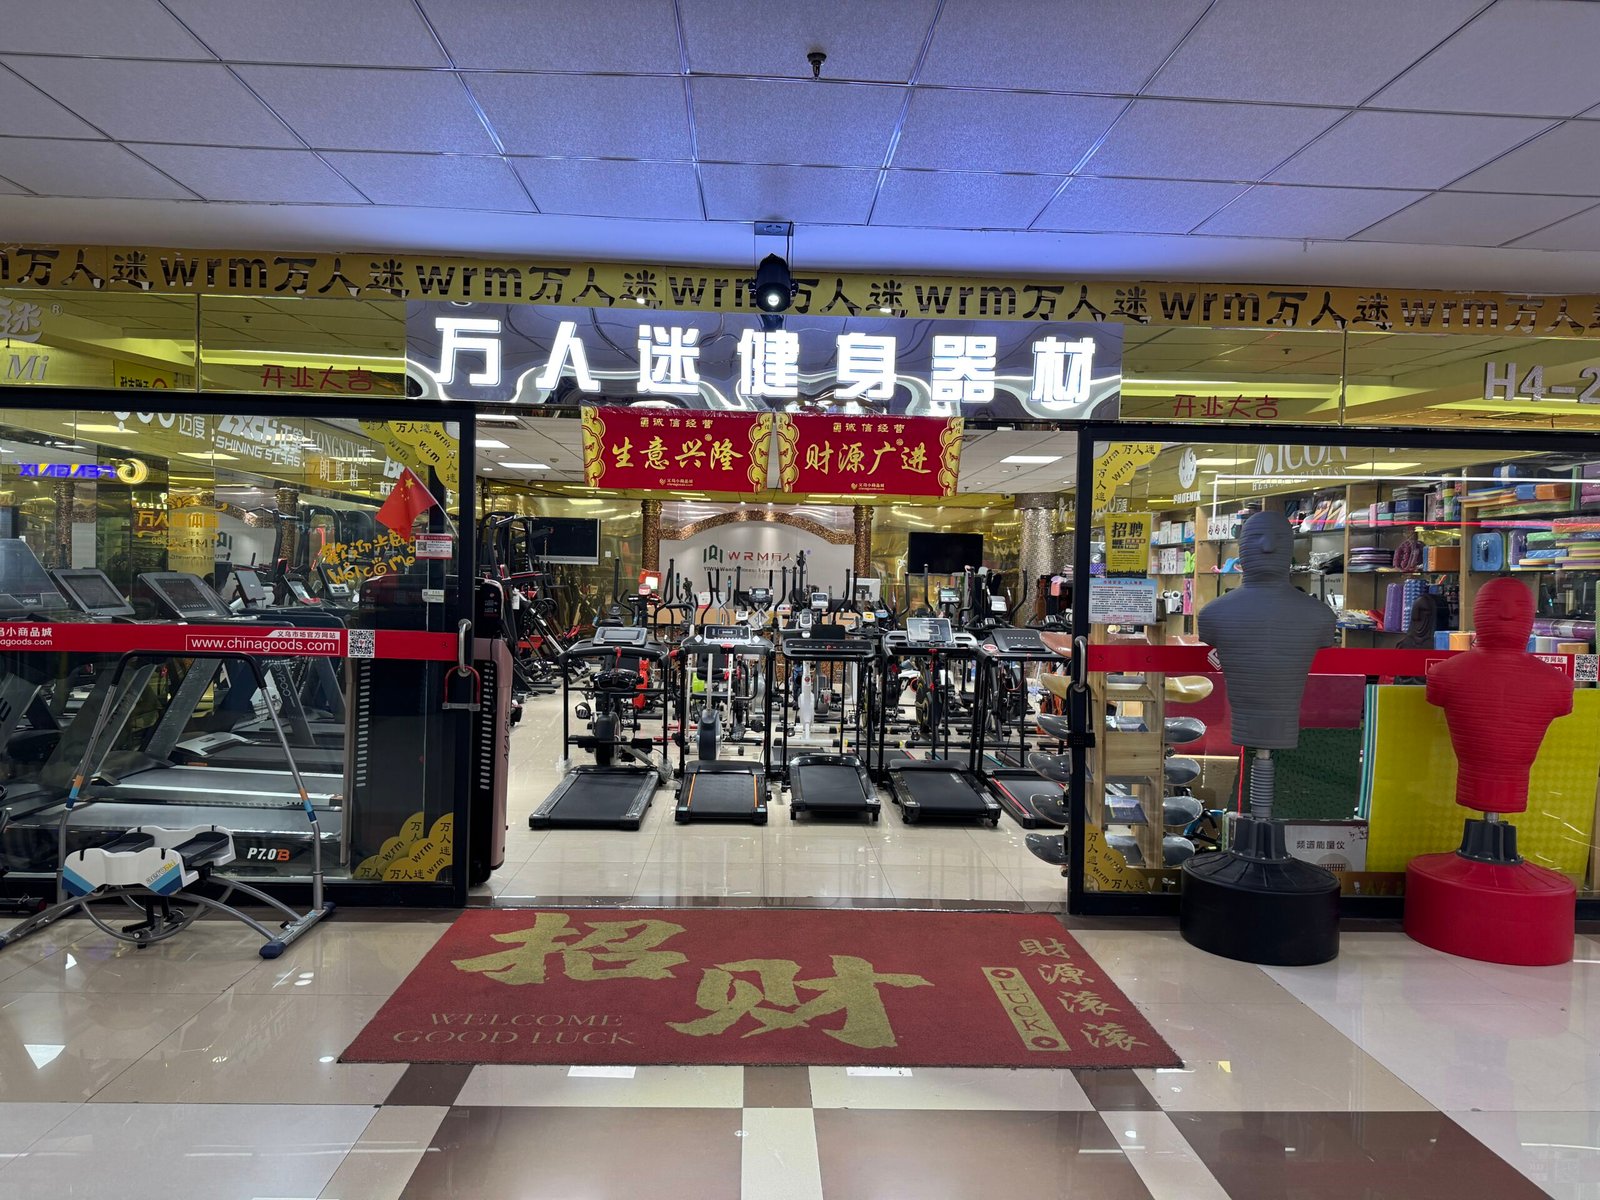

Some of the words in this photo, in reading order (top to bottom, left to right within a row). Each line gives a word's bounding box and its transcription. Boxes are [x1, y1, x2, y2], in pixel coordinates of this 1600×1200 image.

[17, 249, 154, 291] 万人迷
[161, 256, 267, 288] wrm
[274, 257, 410, 297] 万人迷
[415, 264, 522, 297] wrm
[529, 266, 662, 309] 万人迷
[915, 284, 1016, 315] wrm
[1022, 284, 1152, 324] 万人迷
[1159, 291, 1259, 322] wrm
[1266, 290, 1393, 331] 万人迷
[1400, 297, 1498, 328] wrm
[6, 354, 50, 381] Mi
[435, 316, 1096, 404] 万人迷健身器材
[260, 364, 373, 392] 开业大吉
[1173, 393, 1279, 418] 开业大吉
[215, 435, 263, 459] SHINING
[612, 435, 744, 471] 生意兴隆
[804, 440, 932, 476] 财源广进
[1111, 521, 1143, 538] 招聘
[728, 551, 769, 561] WRM
[191, 638, 335, 652] www.chinagoods.com
[277, 630, 336, 639] 义乌市场官方网站
[247, 847, 290, 861] P7.0B
[382, 840, 405, 862] wrm
[411, 841, 434, 863] wrm
[426, 856, 445, 876] wrm
[996, 981, 1049, 1032] LUCK
[431, 1013, 623, 1026] WELCOME
[393, 1031, 518, 1044] GOOD
[531, 1031, 635, 1046] LUCK
